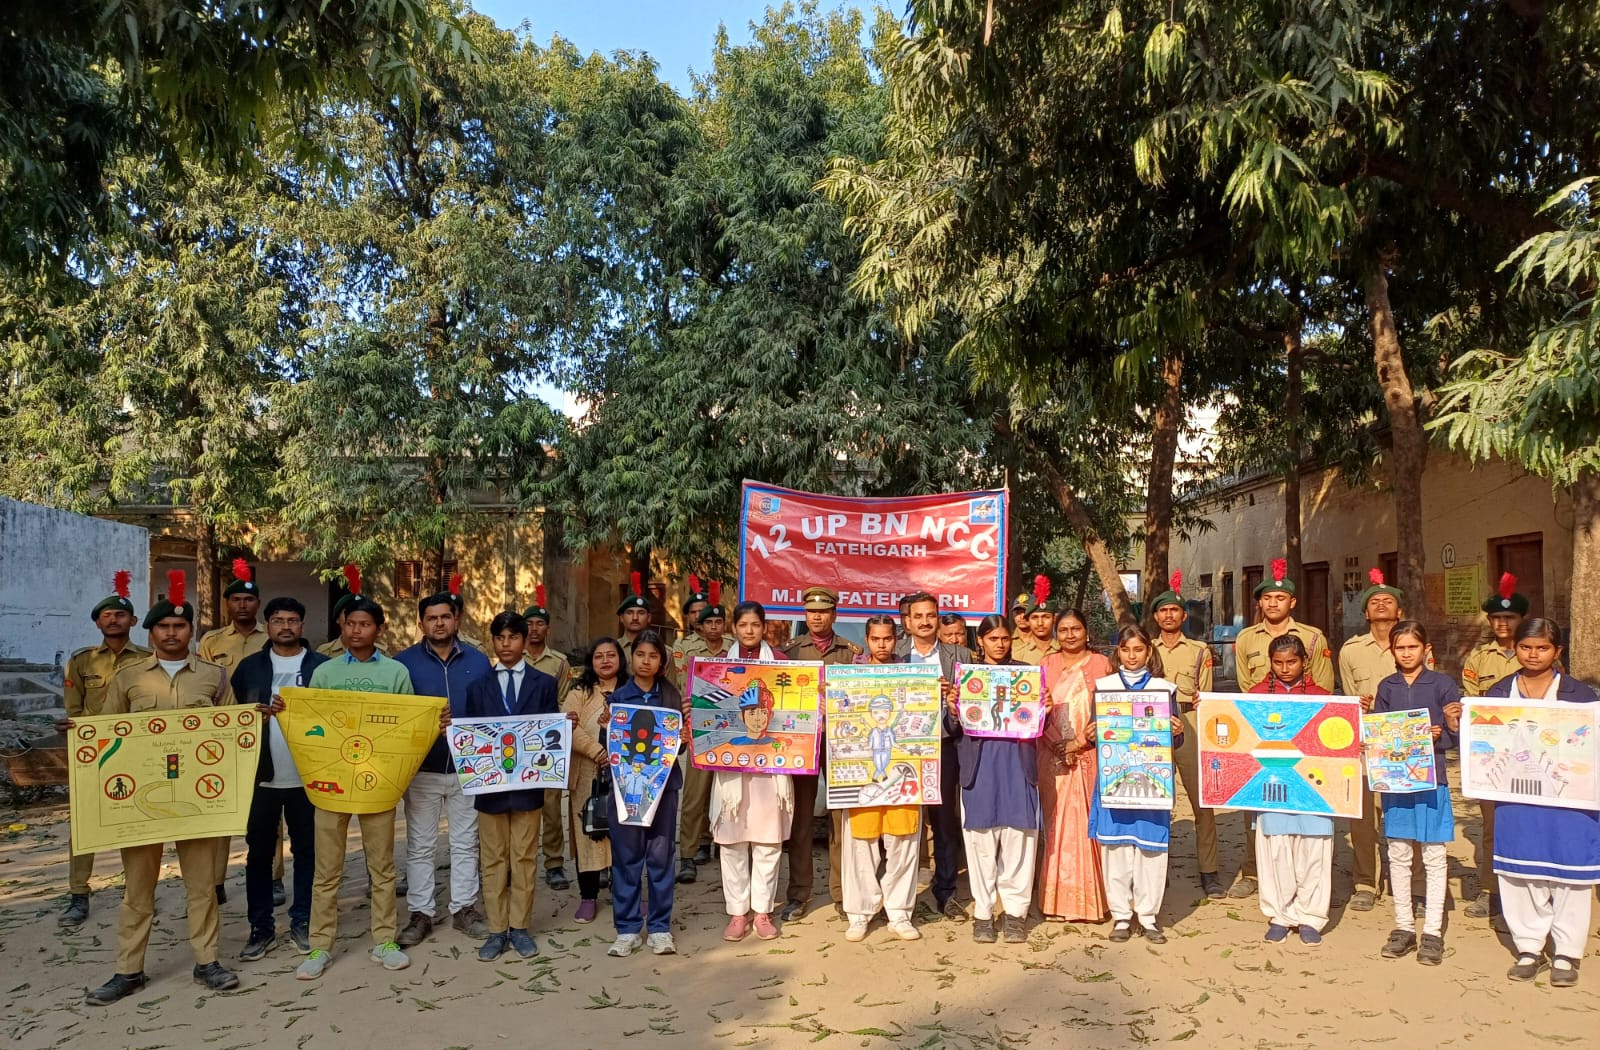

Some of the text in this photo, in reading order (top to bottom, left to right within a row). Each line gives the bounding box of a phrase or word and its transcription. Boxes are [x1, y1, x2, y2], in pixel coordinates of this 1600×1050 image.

[751, 512, 995, 560] 12 UP BN NCC
[815, 542, 927, 557] FATEHGARH
[1445, 548, 1454, 564] 12
[838, 591, 969, 608] FATEHRH
[1101, 693, 1158, 704] ROAD SAFETY
[187, 719, 198, 727] 30
